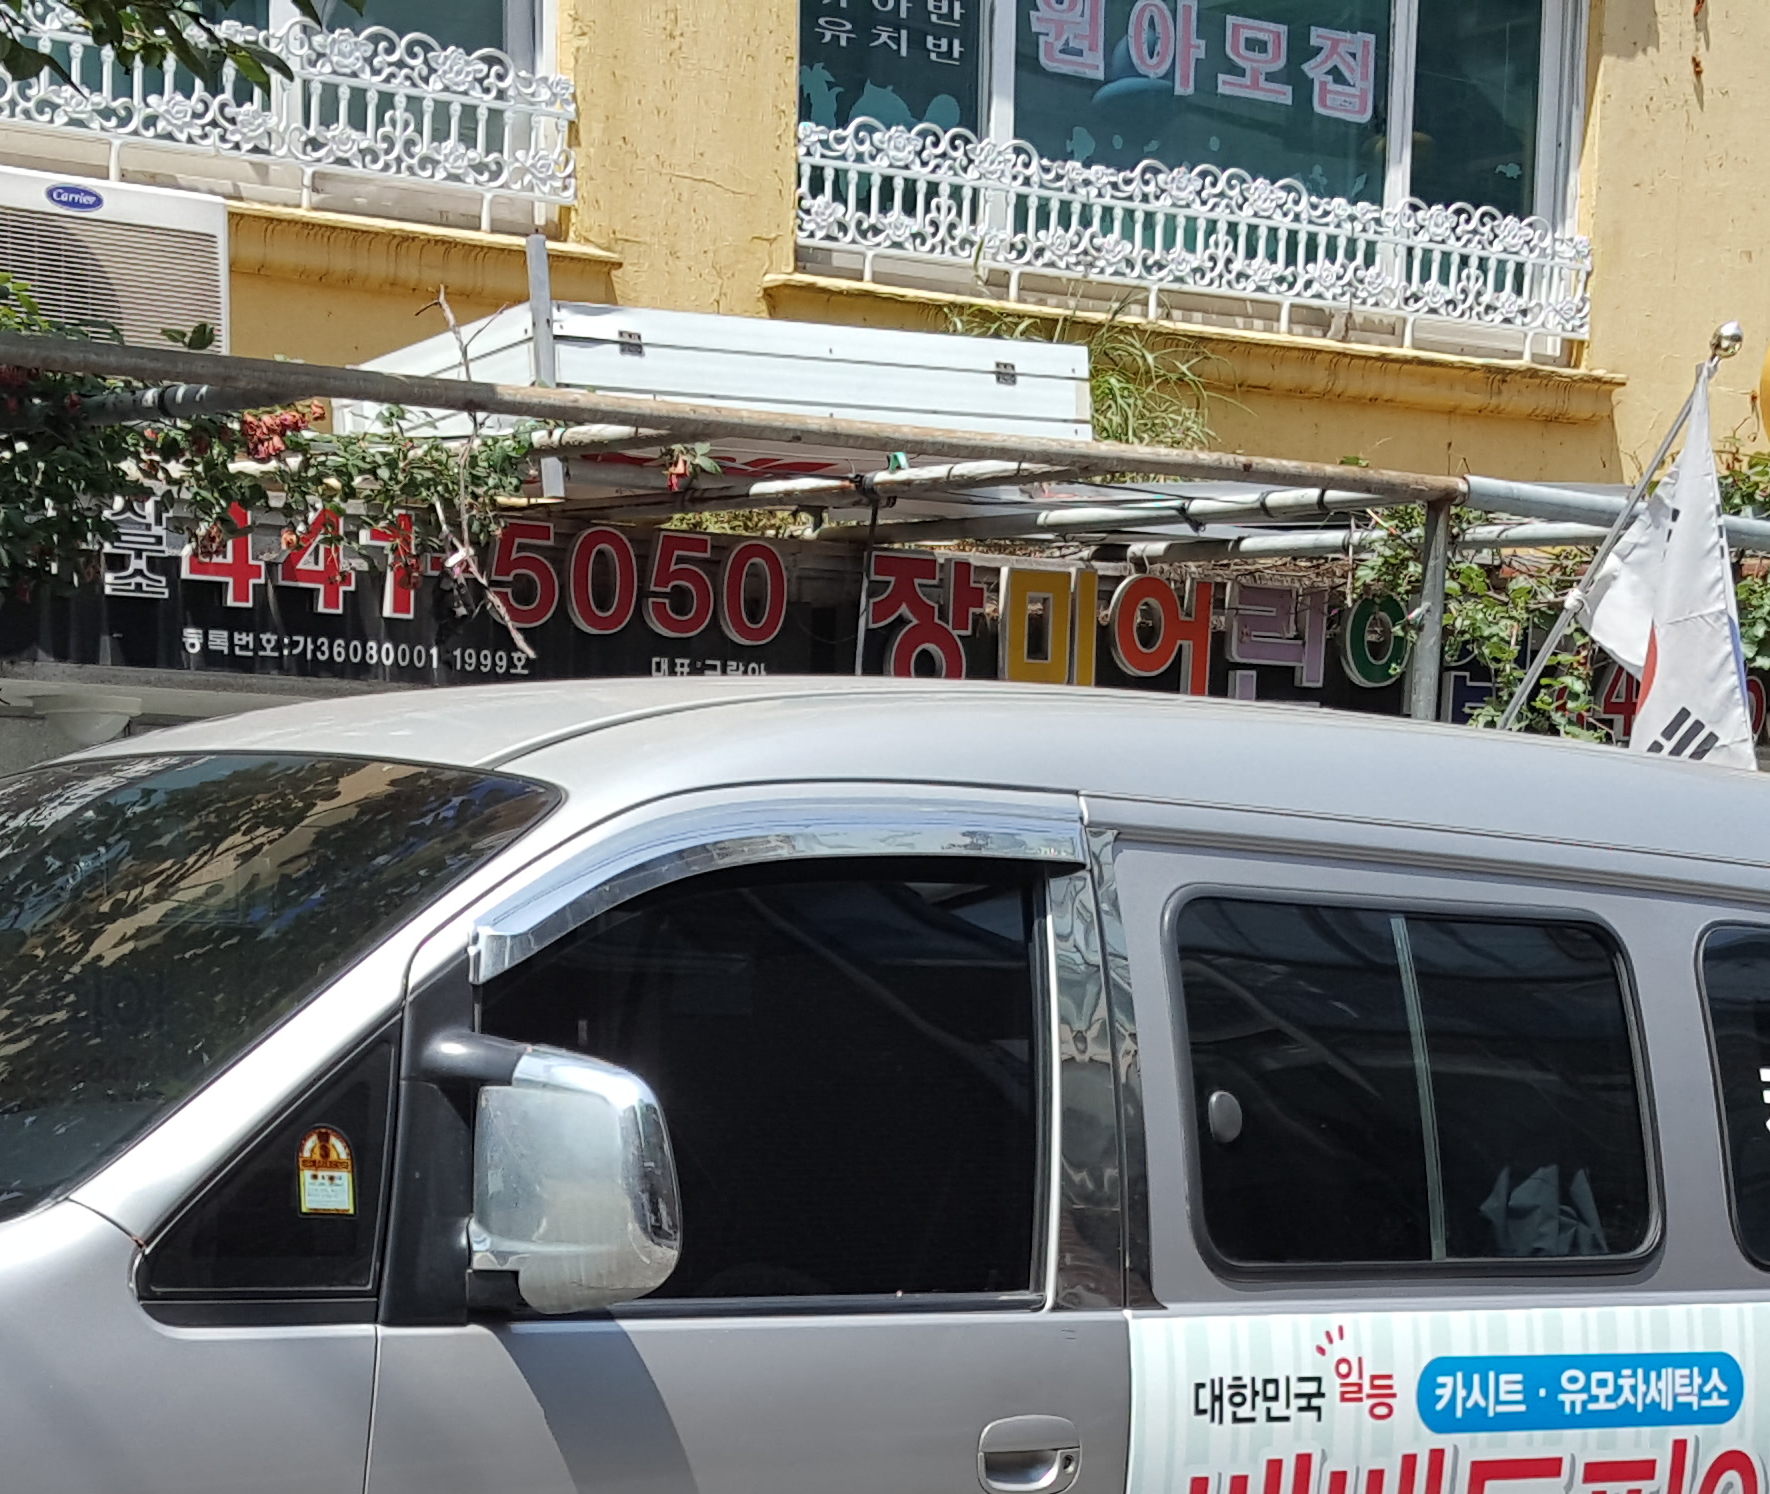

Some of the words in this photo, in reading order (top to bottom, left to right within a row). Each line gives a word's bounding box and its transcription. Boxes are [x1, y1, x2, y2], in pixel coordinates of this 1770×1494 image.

[814, 17, 964, 65] 유치반
[1030, 0, 1375, 123] 원아모집
[52, 188, 97, 206] Carrier
[1193, 1376, 1326, 1425] 대한민국
[1334, 1356, 1397, 1421] 일등
[1434, 1368, 1527, 1418] 카시트
[1557, 1366, 1730, 1414] 유모차세탁소
